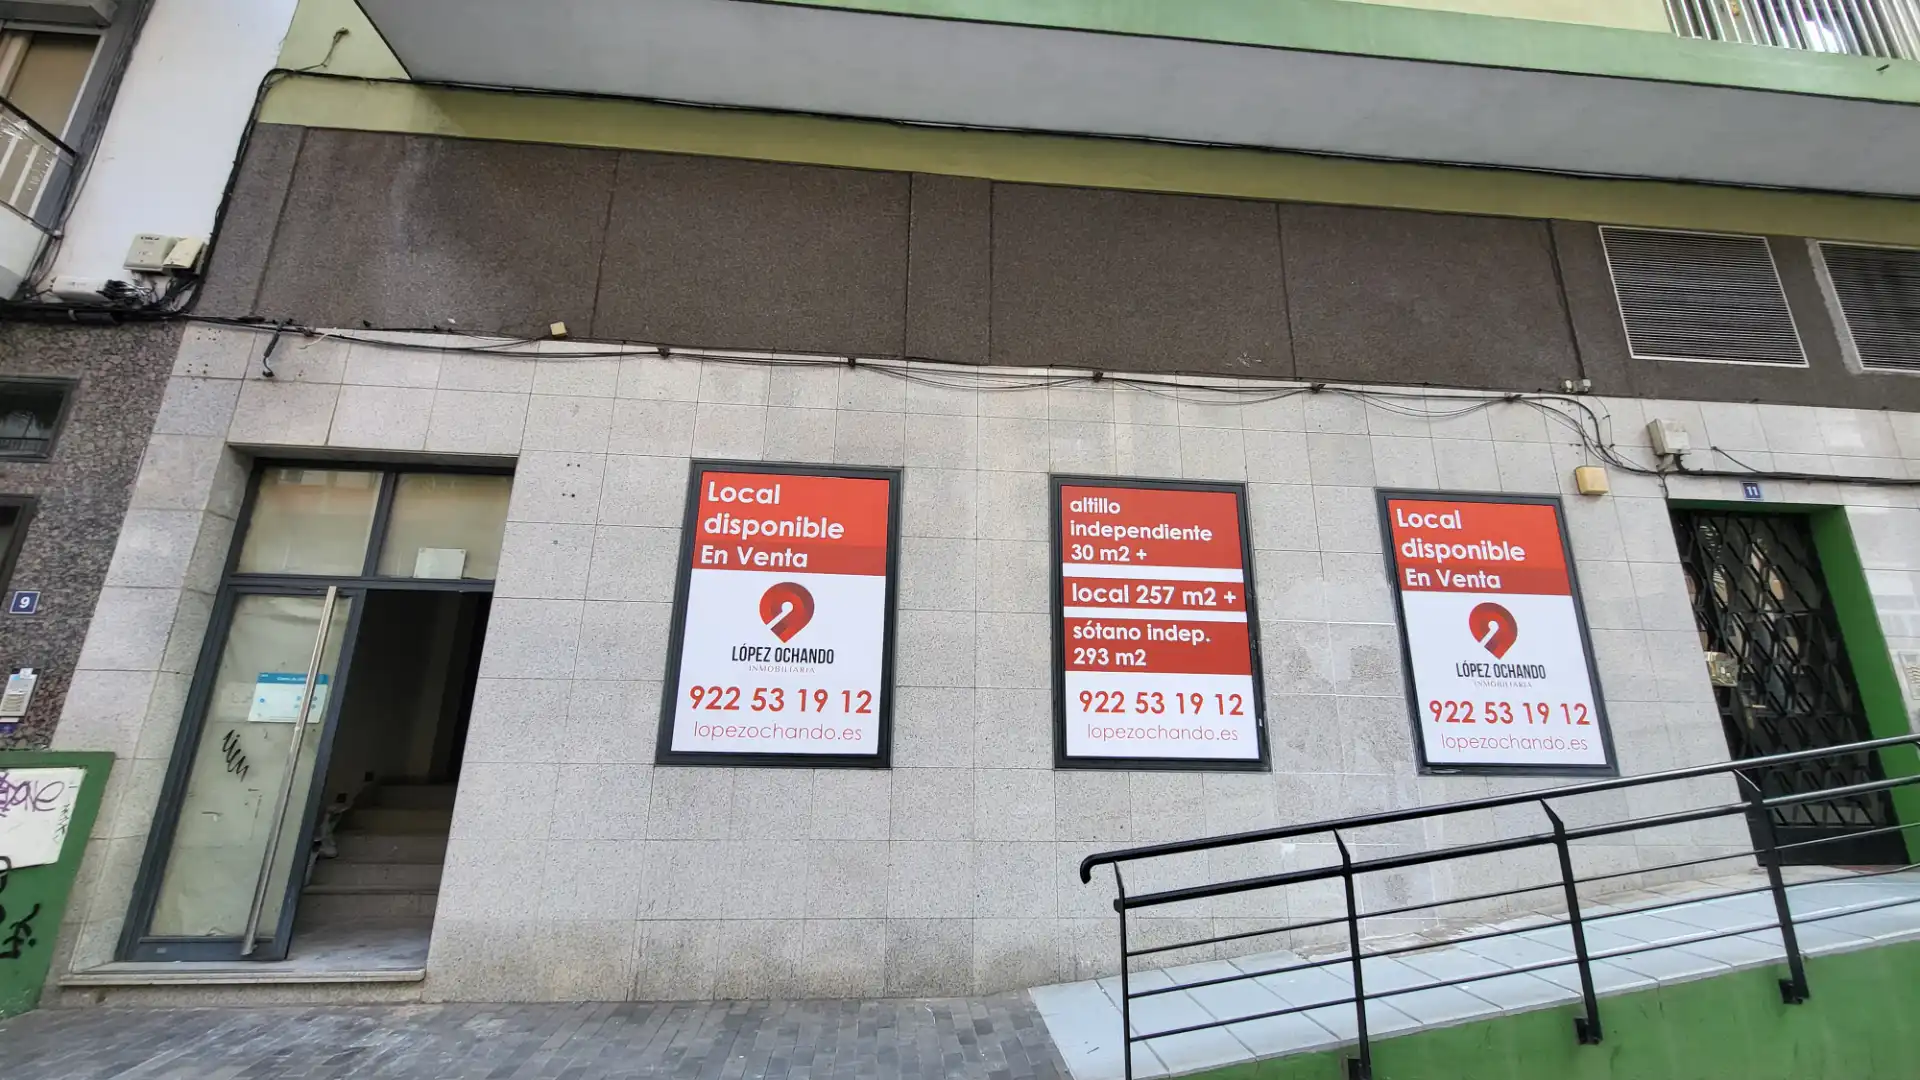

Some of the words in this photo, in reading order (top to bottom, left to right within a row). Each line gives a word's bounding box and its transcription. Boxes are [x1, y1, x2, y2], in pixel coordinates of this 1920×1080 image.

[707, 481, 781, 505] Local
[1746, 486, 1759, 496] 11
[1069, 497, 1121, 515] altillo
[703, 513, 845, 540] disponible
[1396, 508, 1462, 530] Local
[1070, 520, 1213, 542] independiente
[700, 545, 728, 565] En
[737, 546, 808, 568] Venta
[1071, 544, 1094, 561] 30
[1099, 546, 1131, 562] m2
[1401, 538, 1526, 564] disponible
[1405, 568, 1431, 587] En
[1436, 569, 1502, 589] Venta
[19, 596, 31, 609] 9
[1071, 583, 1129, 604] local
[1136, 585, 1175, 604] 257
[1182, 587, 1217, 606] m2
[1072, 620, 1142, 640] sótano
[1147, 624, 1211, 645] indep.
[731, 643, 772, 663] LÓPEZ
[774, 648, 835, 665] OCHANDO
[1073, 647, 1109, 666] 293
[1115, 649, 1147, 667] m2
[1455, 660, 1492, 678] LÓPEZ
[1493, 664, 1547, 680] OCHANDO
[689, 685, 741, 711] 922
[750, 687, 785, 712] 53
[798, 689, 829, 713] 19
[842, 690, 873, 714] 12
[1079, 690, 1126, 714] 922
[1135, 692, 1166, 714] 53
[1176, 692, 1204, 715] 19
[1214, 694, 1244, 716] 12
[1429, 700, 1476, 724] 922
[1484, 701, 1514, 724] 53
[1522, 702, 1550, 725] 19
[1560, 703, 1591, 726] 12
[693, 721, 862, 742] lopezochando.es
[1087, 723, 1239, 742] lopezochando.es
[1440, 733, 1589, 752] lopezochando.es
